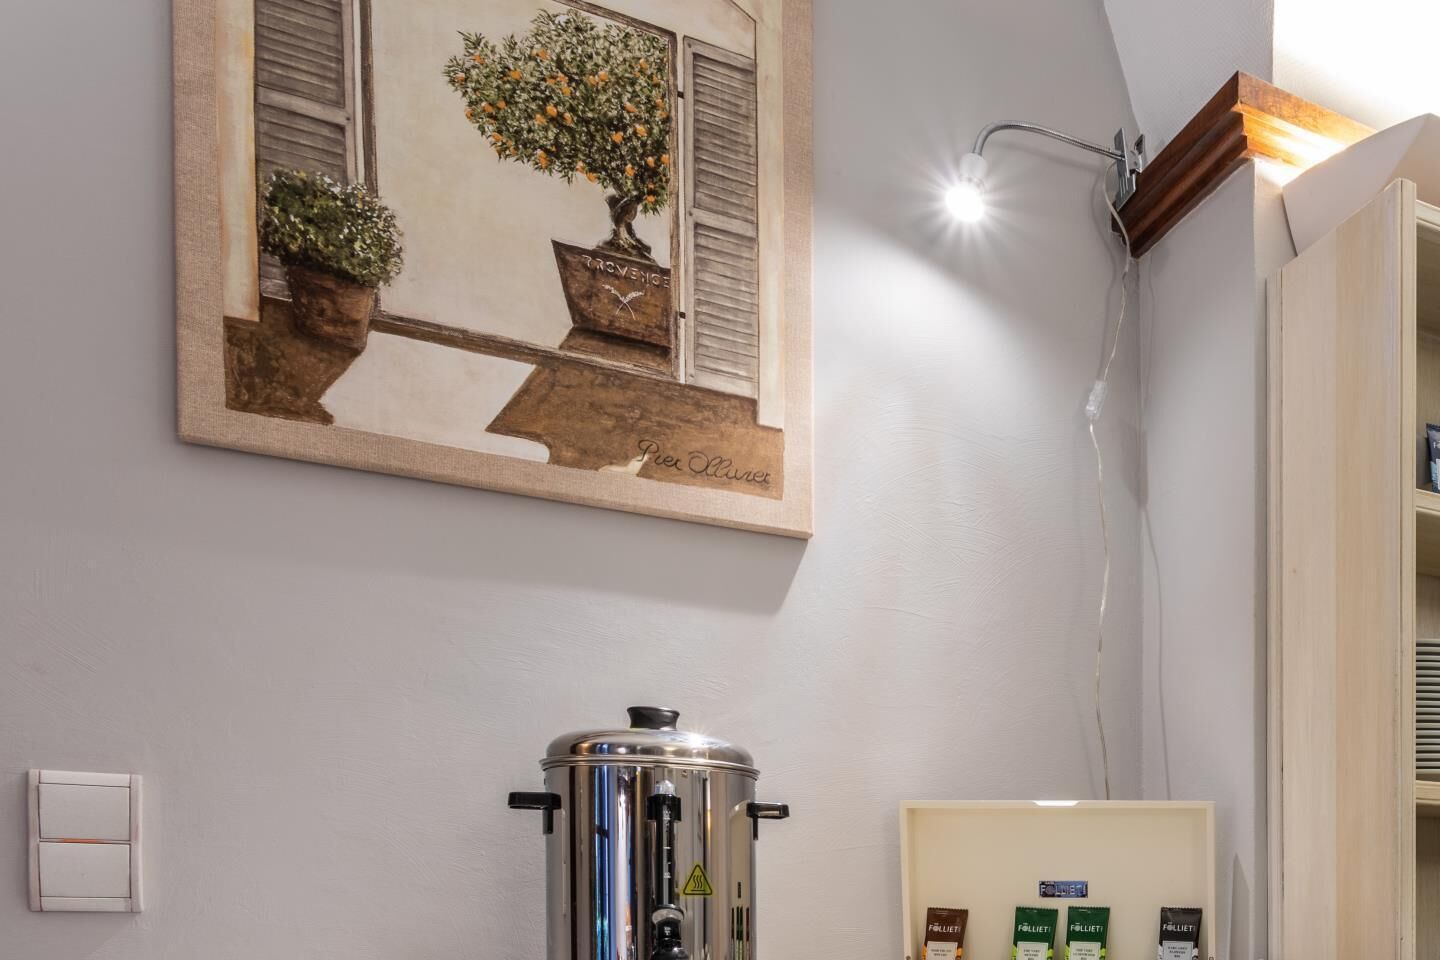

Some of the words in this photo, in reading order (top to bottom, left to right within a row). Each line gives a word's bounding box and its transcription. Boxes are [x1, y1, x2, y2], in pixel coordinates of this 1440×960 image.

[928, 924, 958, 933] FOLLIET
[1017, 924, 1047, 933] FOLLIET
[1070, 924, 1099, 933] FOLLIET
[1162, 923, 1193, 932] FOLLIET
